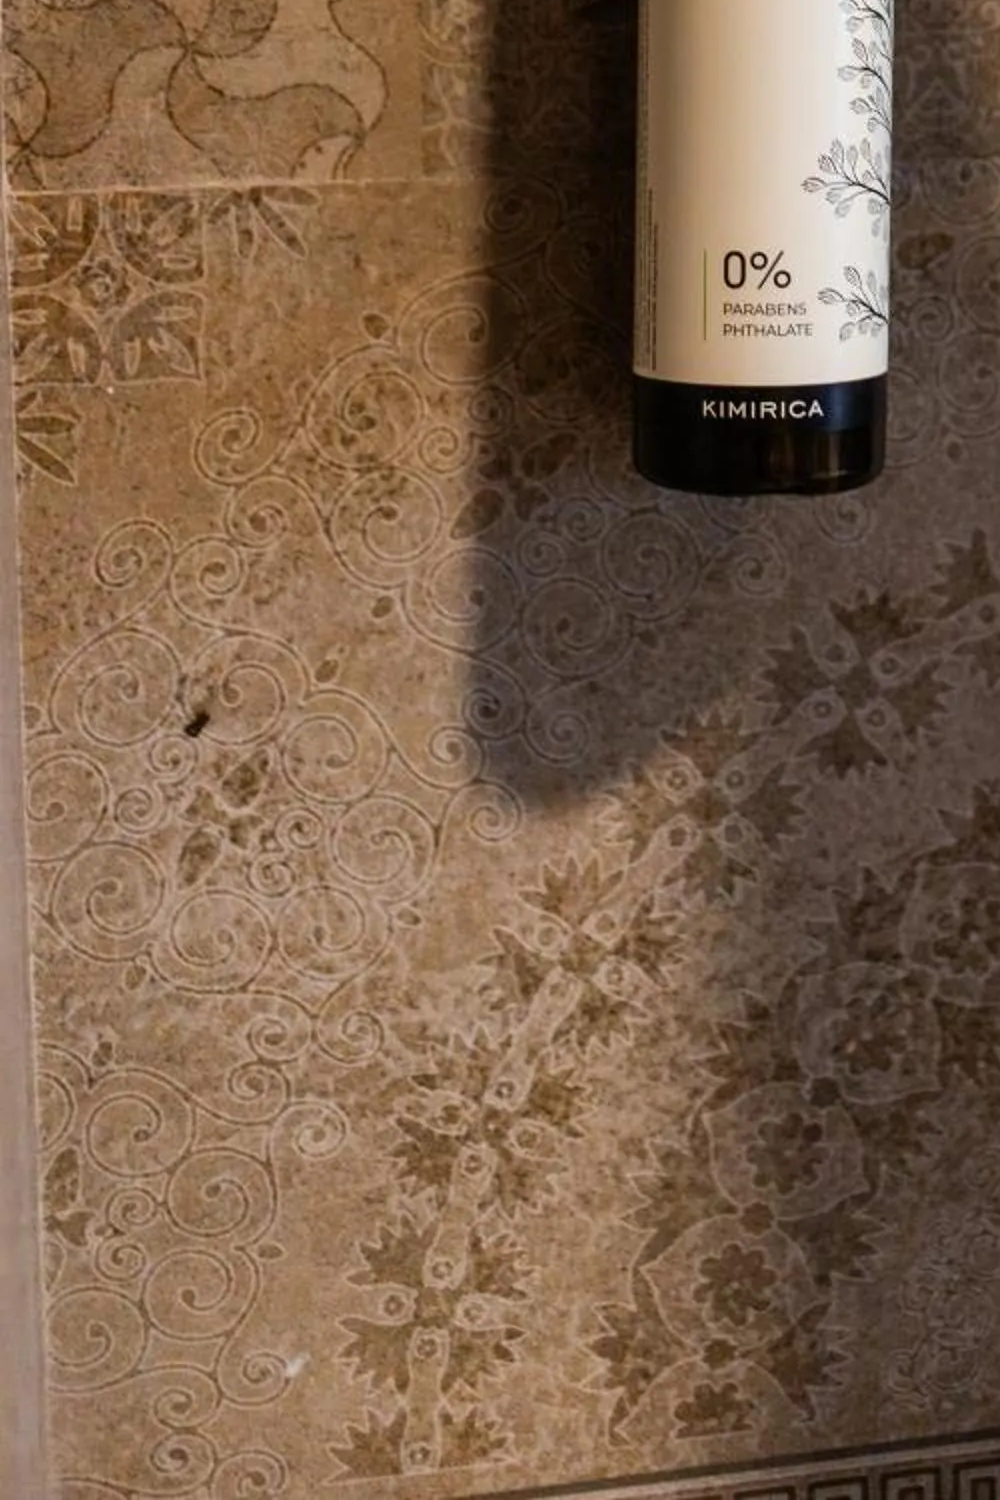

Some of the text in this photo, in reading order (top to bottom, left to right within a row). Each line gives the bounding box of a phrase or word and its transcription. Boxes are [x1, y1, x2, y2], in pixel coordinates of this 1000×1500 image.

[723, 250, 791, 290] 0%
[723, 303, 807, 316] PARABENS
[723, 324, 813, 337] PHTHALATE
[702, 400, 824, 419] KIMIRICA
